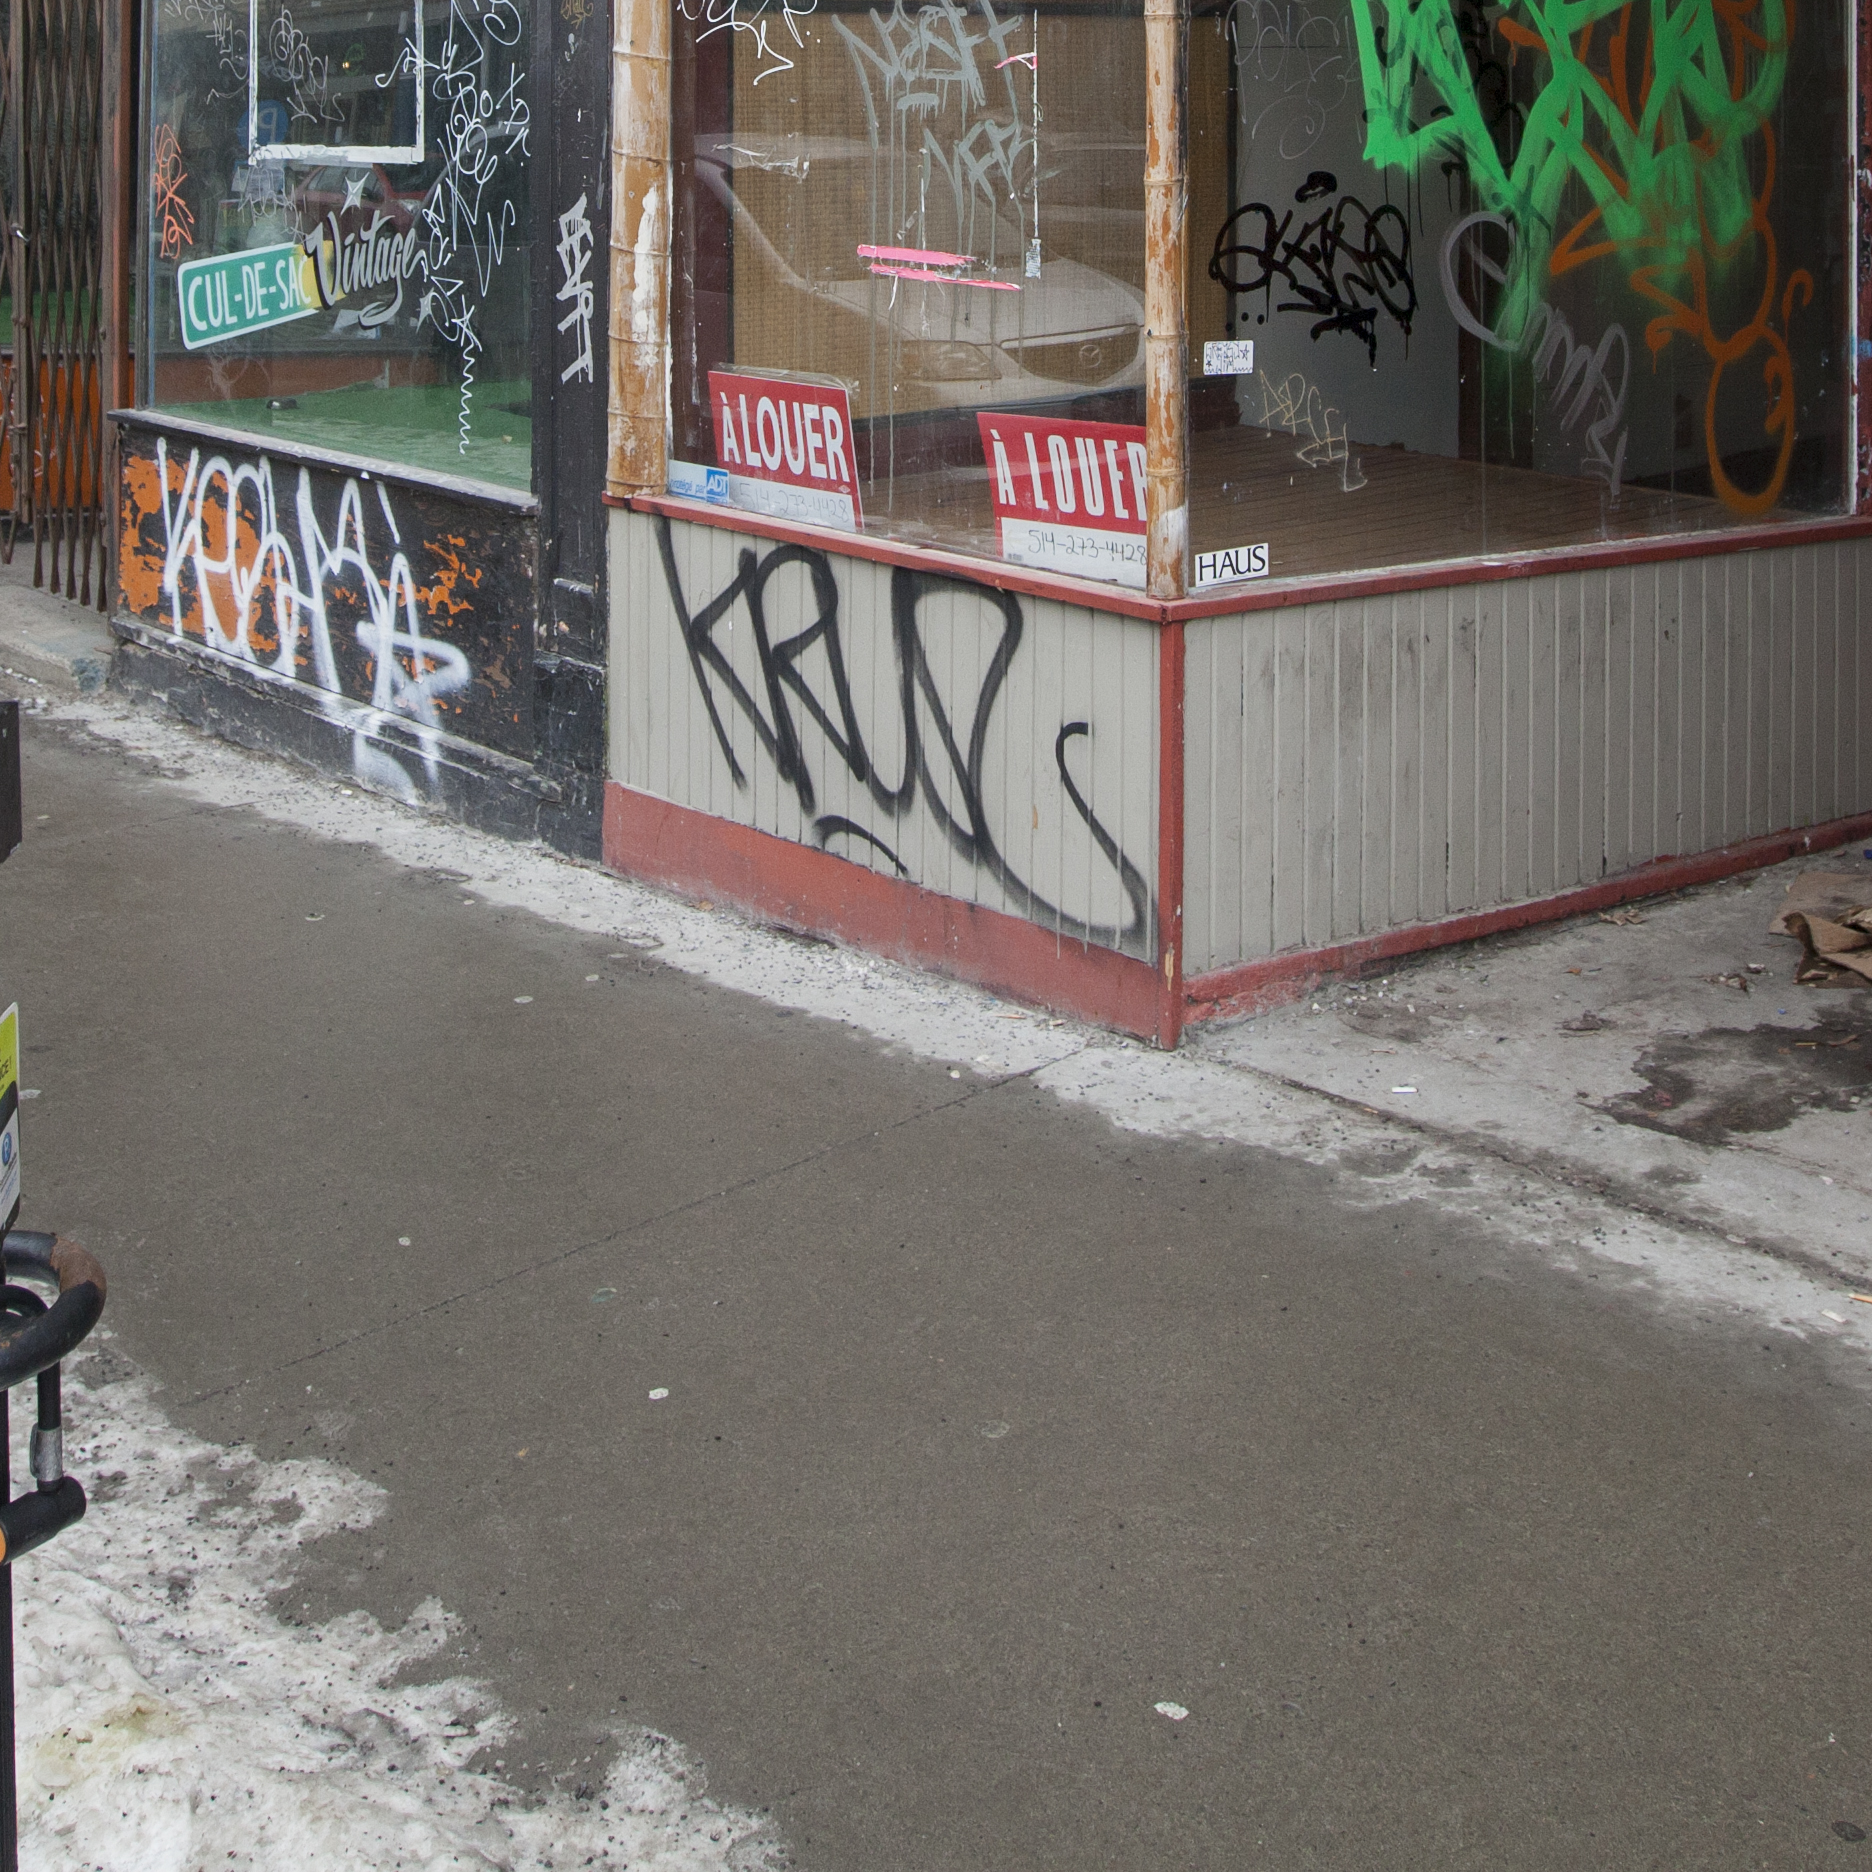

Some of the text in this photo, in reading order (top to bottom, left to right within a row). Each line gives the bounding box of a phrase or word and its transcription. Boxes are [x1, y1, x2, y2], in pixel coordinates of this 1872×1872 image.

[186, 209, 428, 332] CUL-DE-SAC Vintage
[719, 391, 850, 483] À LOUER
[990, 429, 1147, 522] À LOUER
[707, 475, 728, 493] ADT
[1198, 546, 1267, 582] HAUS
